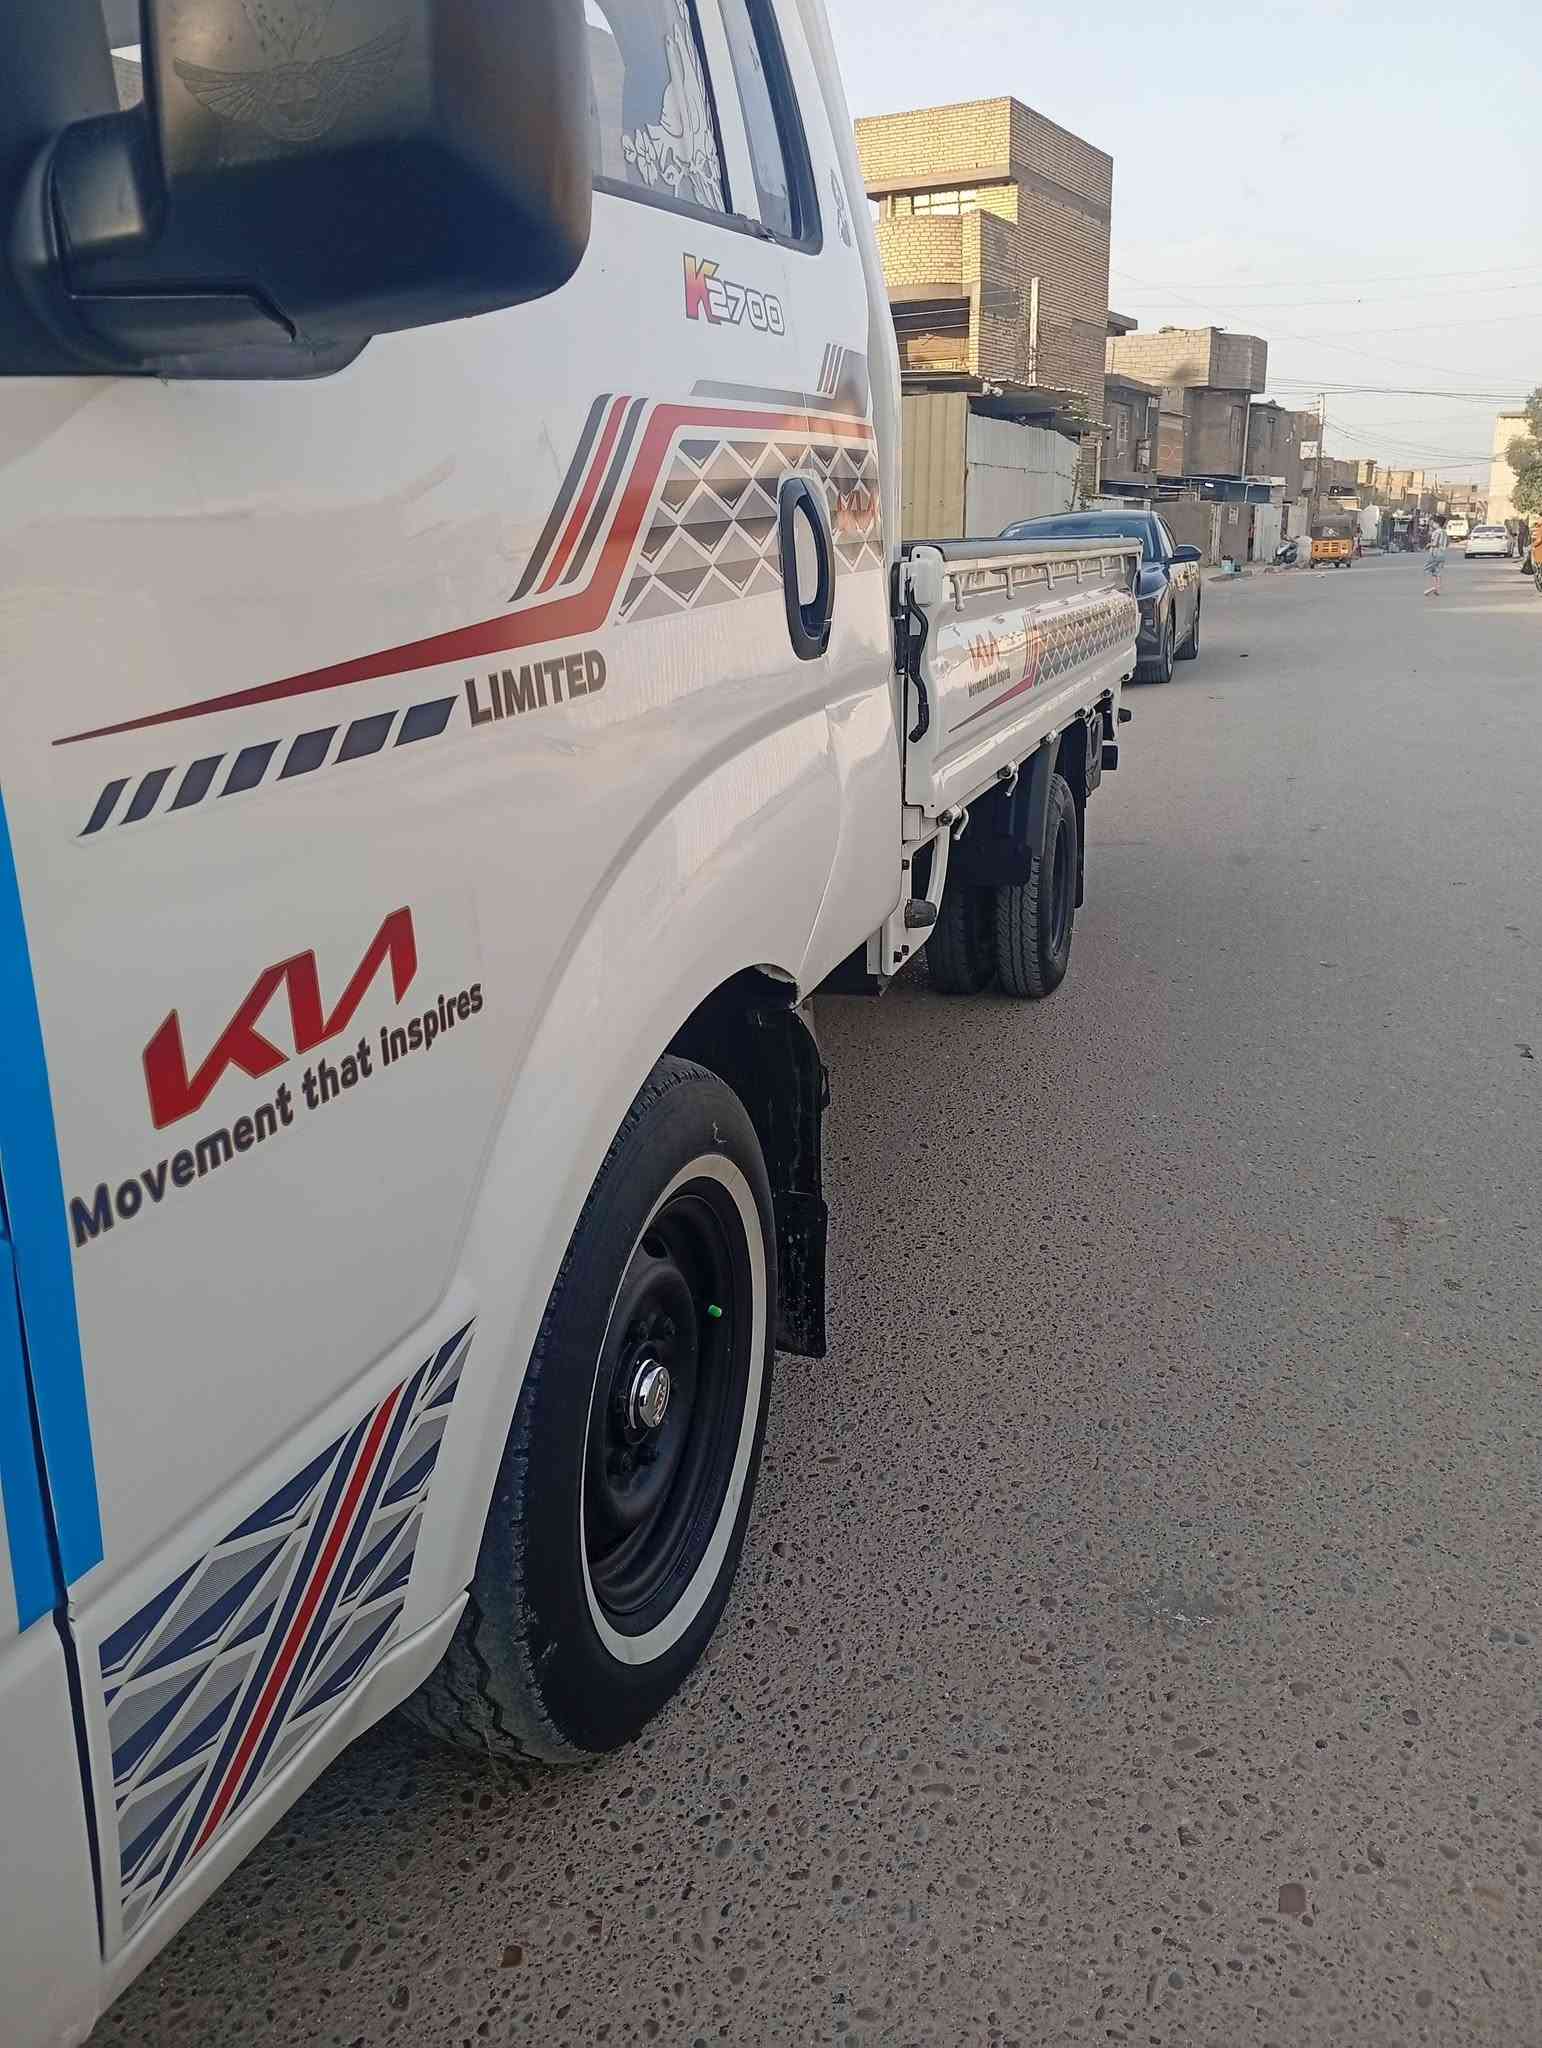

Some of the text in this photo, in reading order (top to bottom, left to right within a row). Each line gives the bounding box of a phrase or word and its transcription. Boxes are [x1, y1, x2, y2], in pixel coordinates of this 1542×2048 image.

[683, 252, 785, 336] K2700
[464, 649, 607, 728] LIMITED
[142, 905, 418, 1130] KIA
[69, 983, 484, 1248] Movement that inspires
